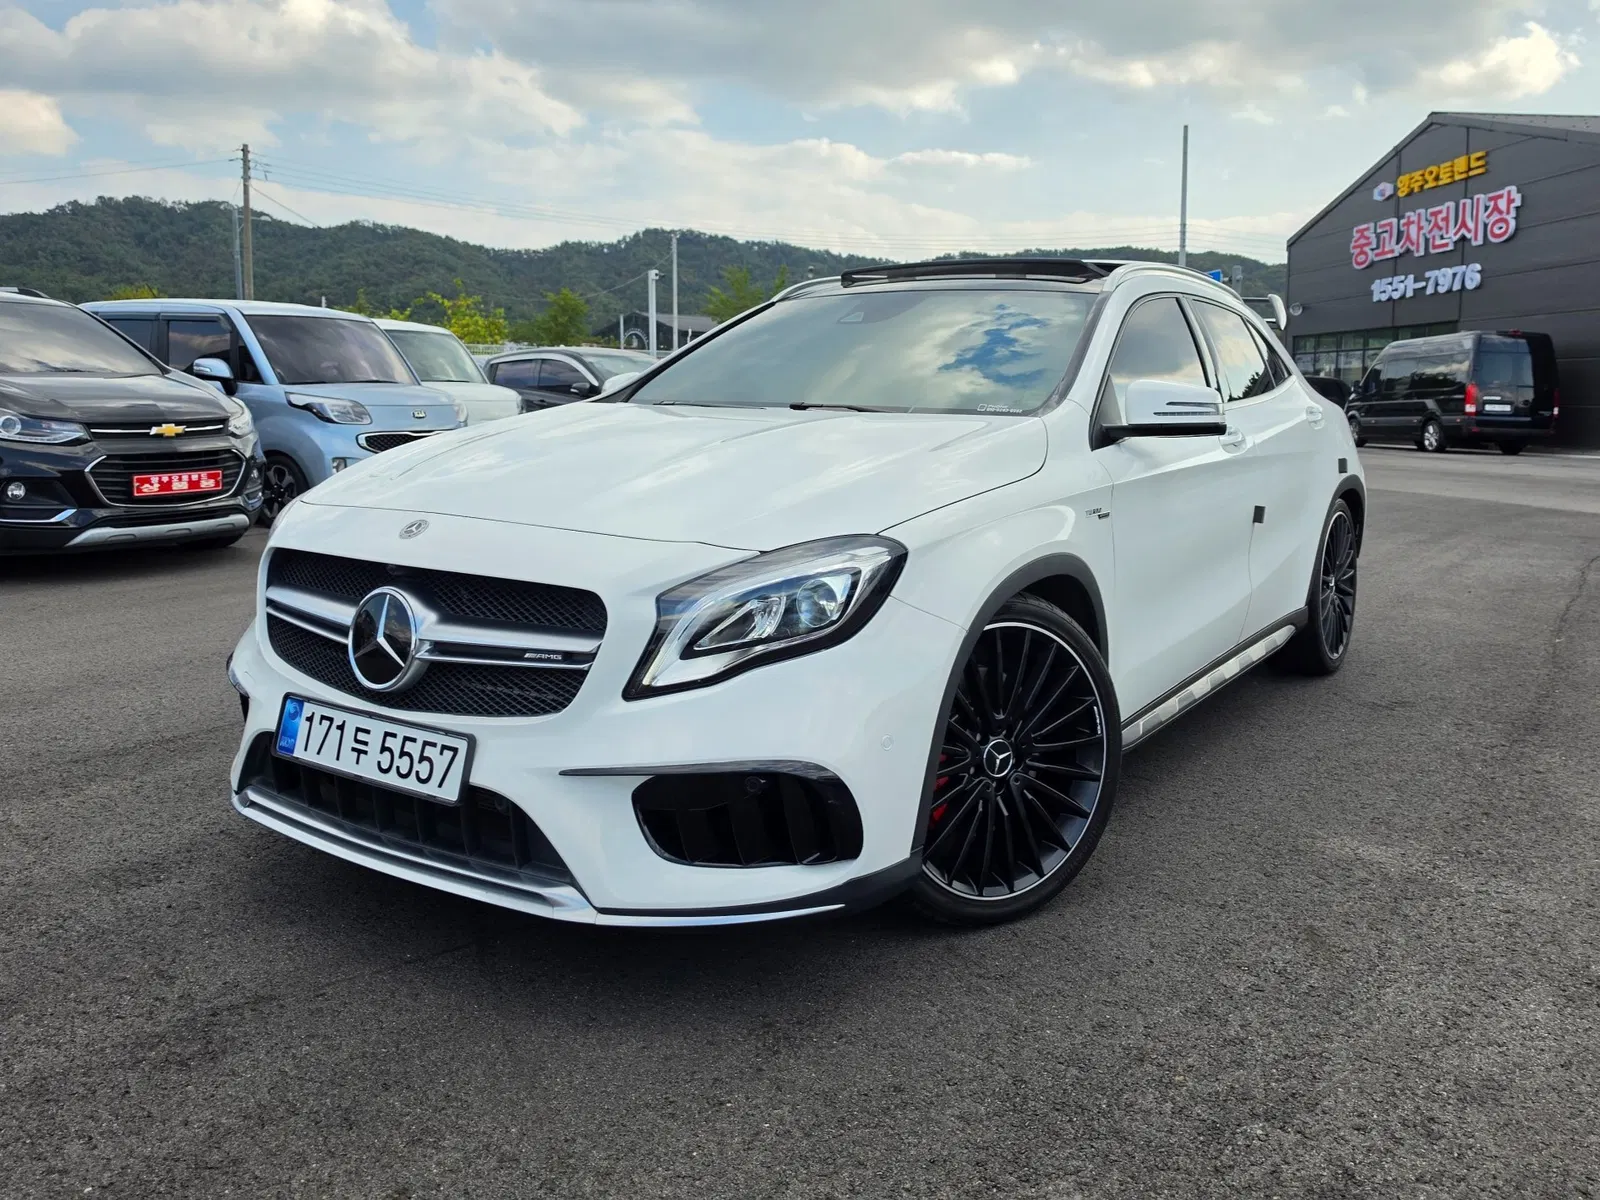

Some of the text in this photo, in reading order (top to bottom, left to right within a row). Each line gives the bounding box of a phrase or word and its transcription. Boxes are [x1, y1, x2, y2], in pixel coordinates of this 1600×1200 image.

[1397, 151, 1487, 197] 양주오토랜드
[1350, 186, 1521, 268] 중고차전시장
[1371, 263, 1482, 302] 1551-7976
[305, 711, 459, 788] 171두 5557
